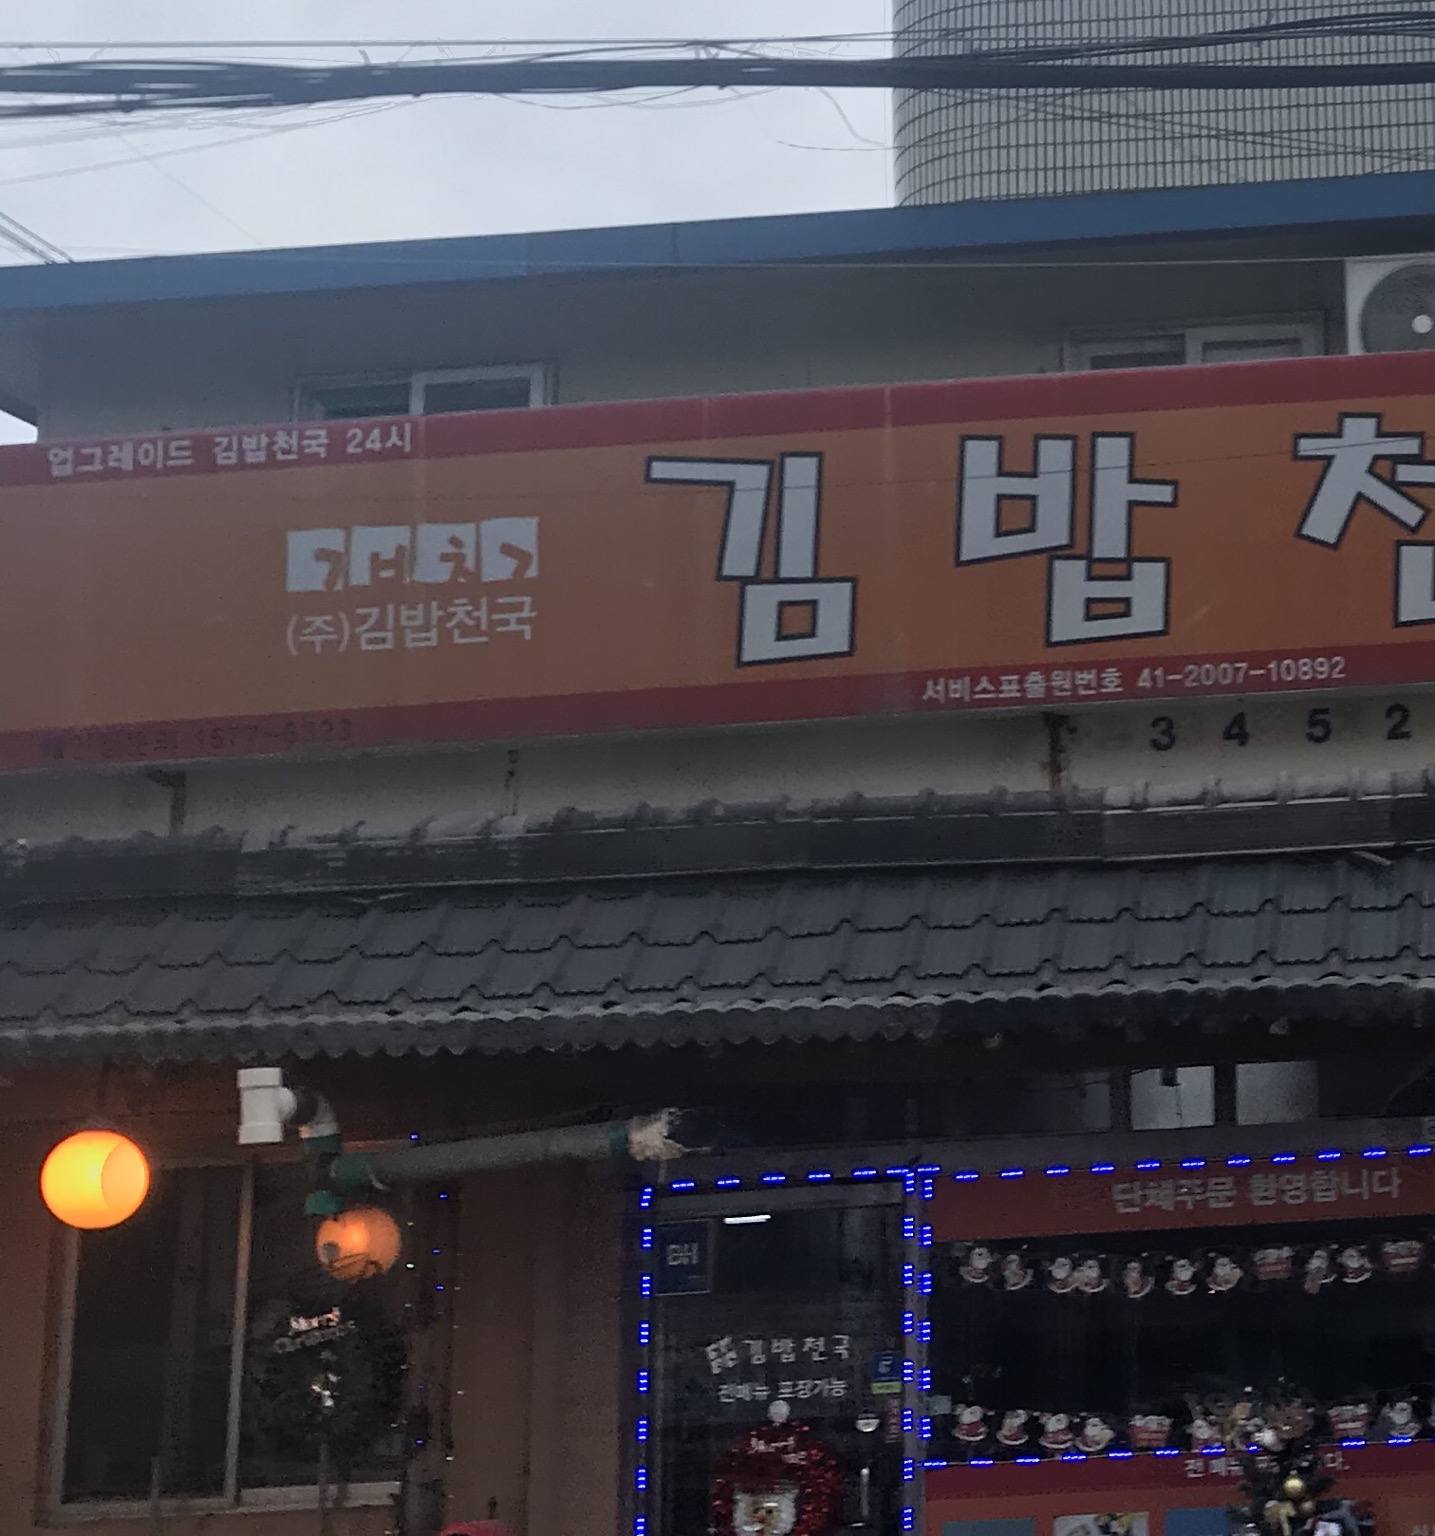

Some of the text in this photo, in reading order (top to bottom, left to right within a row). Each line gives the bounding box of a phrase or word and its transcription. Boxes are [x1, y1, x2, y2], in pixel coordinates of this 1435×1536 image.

[48, 420, 413, 478] 업그레이드 김밥천국 24시
[286, 595, 537, 656] (주)김밥천국
[922, 656, 1346, 702] 서비스표출원번호 41-2007-10892
[1111, 1167, 1401, 1213] 단체주문 환영합니다
